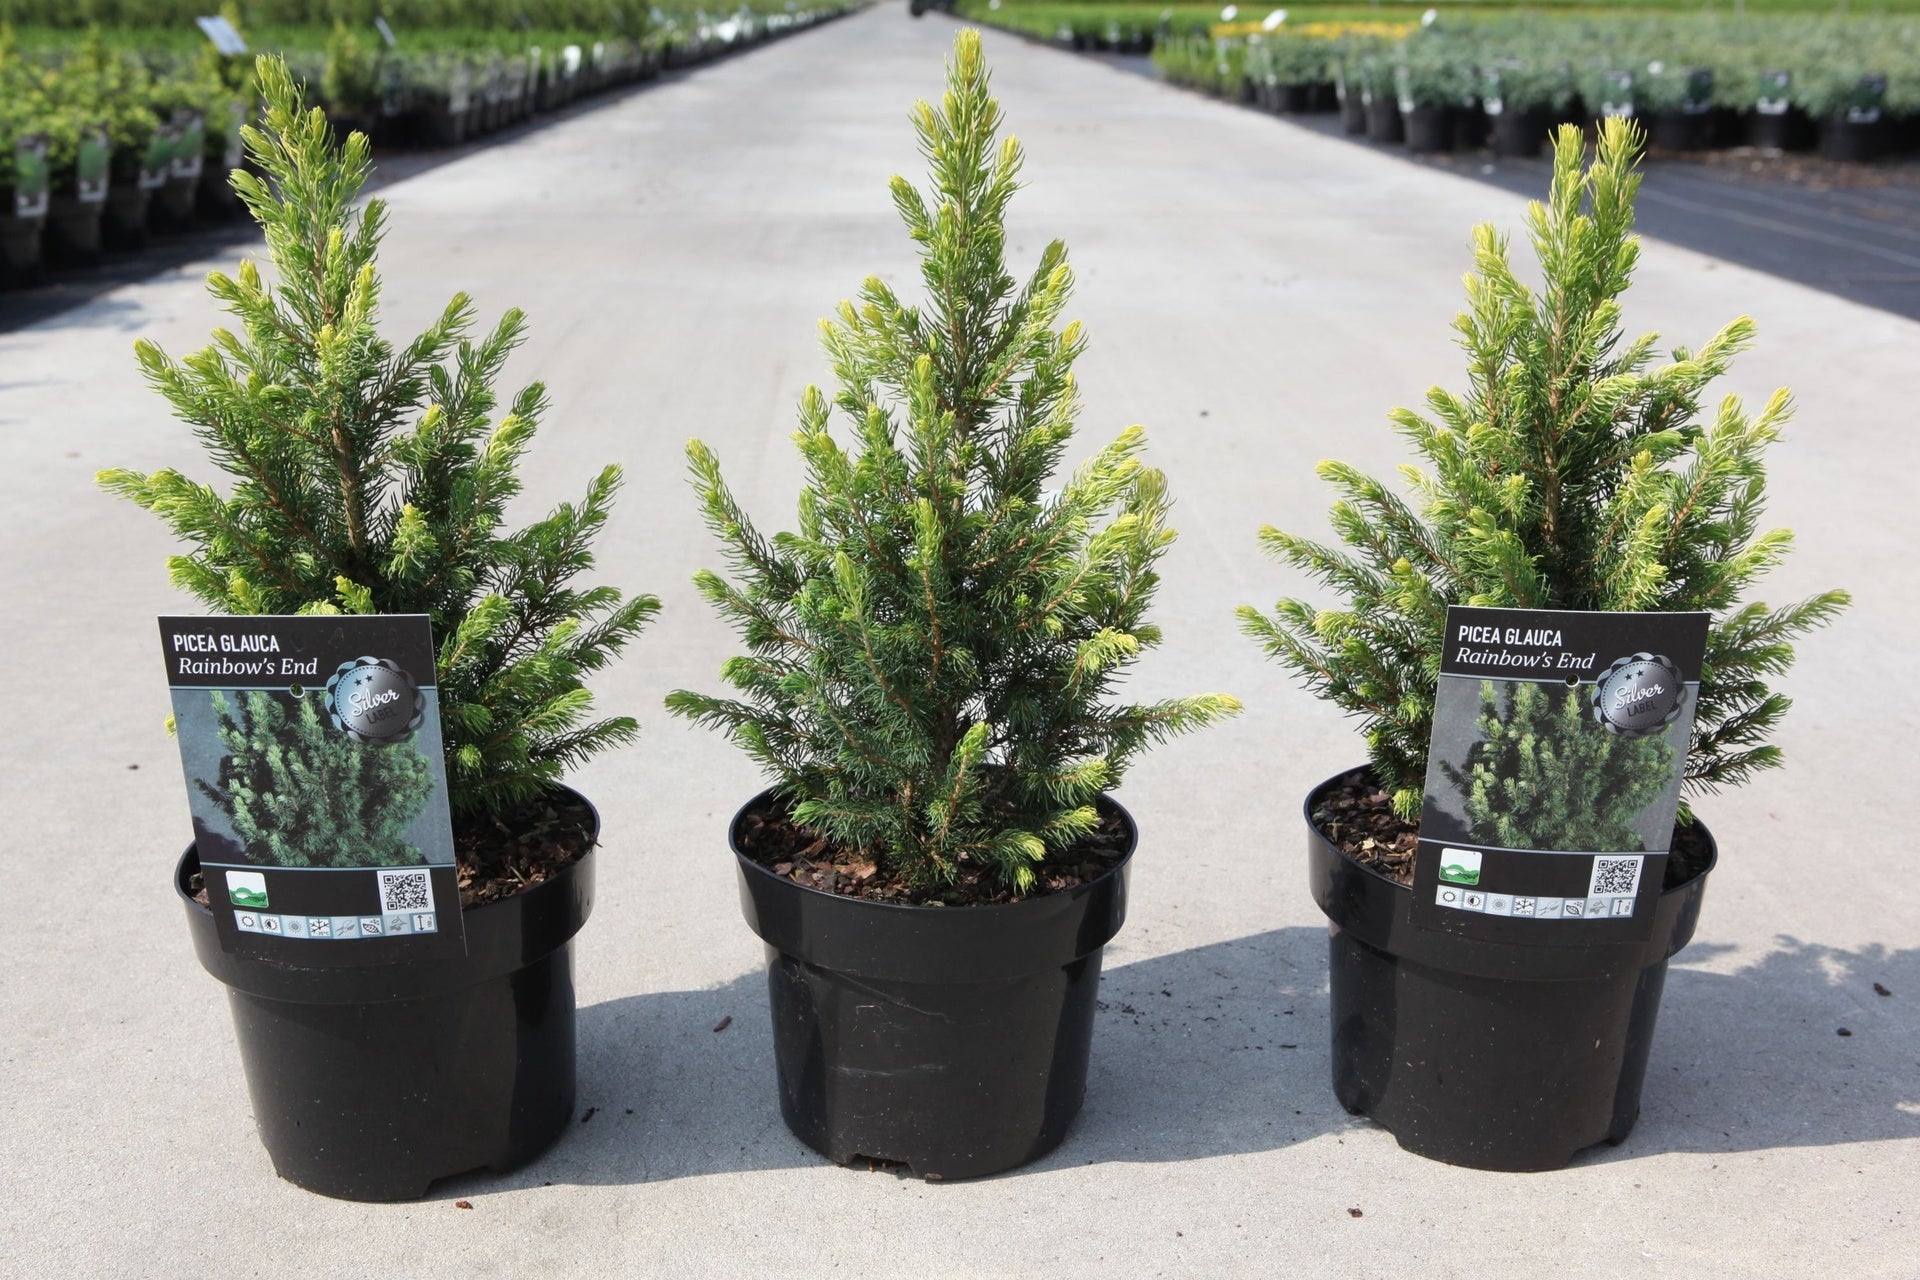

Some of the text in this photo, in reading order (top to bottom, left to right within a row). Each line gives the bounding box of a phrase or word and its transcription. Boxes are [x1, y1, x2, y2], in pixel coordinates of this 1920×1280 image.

[173, 634, 280, 652] PICEA GLAUCA
[1458, 625, 1562, 647] PICEA GLAUCA
[178, 657, 318, 675] Rainbow's End
[1455, 647, 1596, 669] Rainbow's End
[348, 687, 400, 717] Silver
[1614, 682, 1665, 710] Silver
[366, 707, 397, 725] LABEL
[1627, 700, 1656, 717] LABEL
